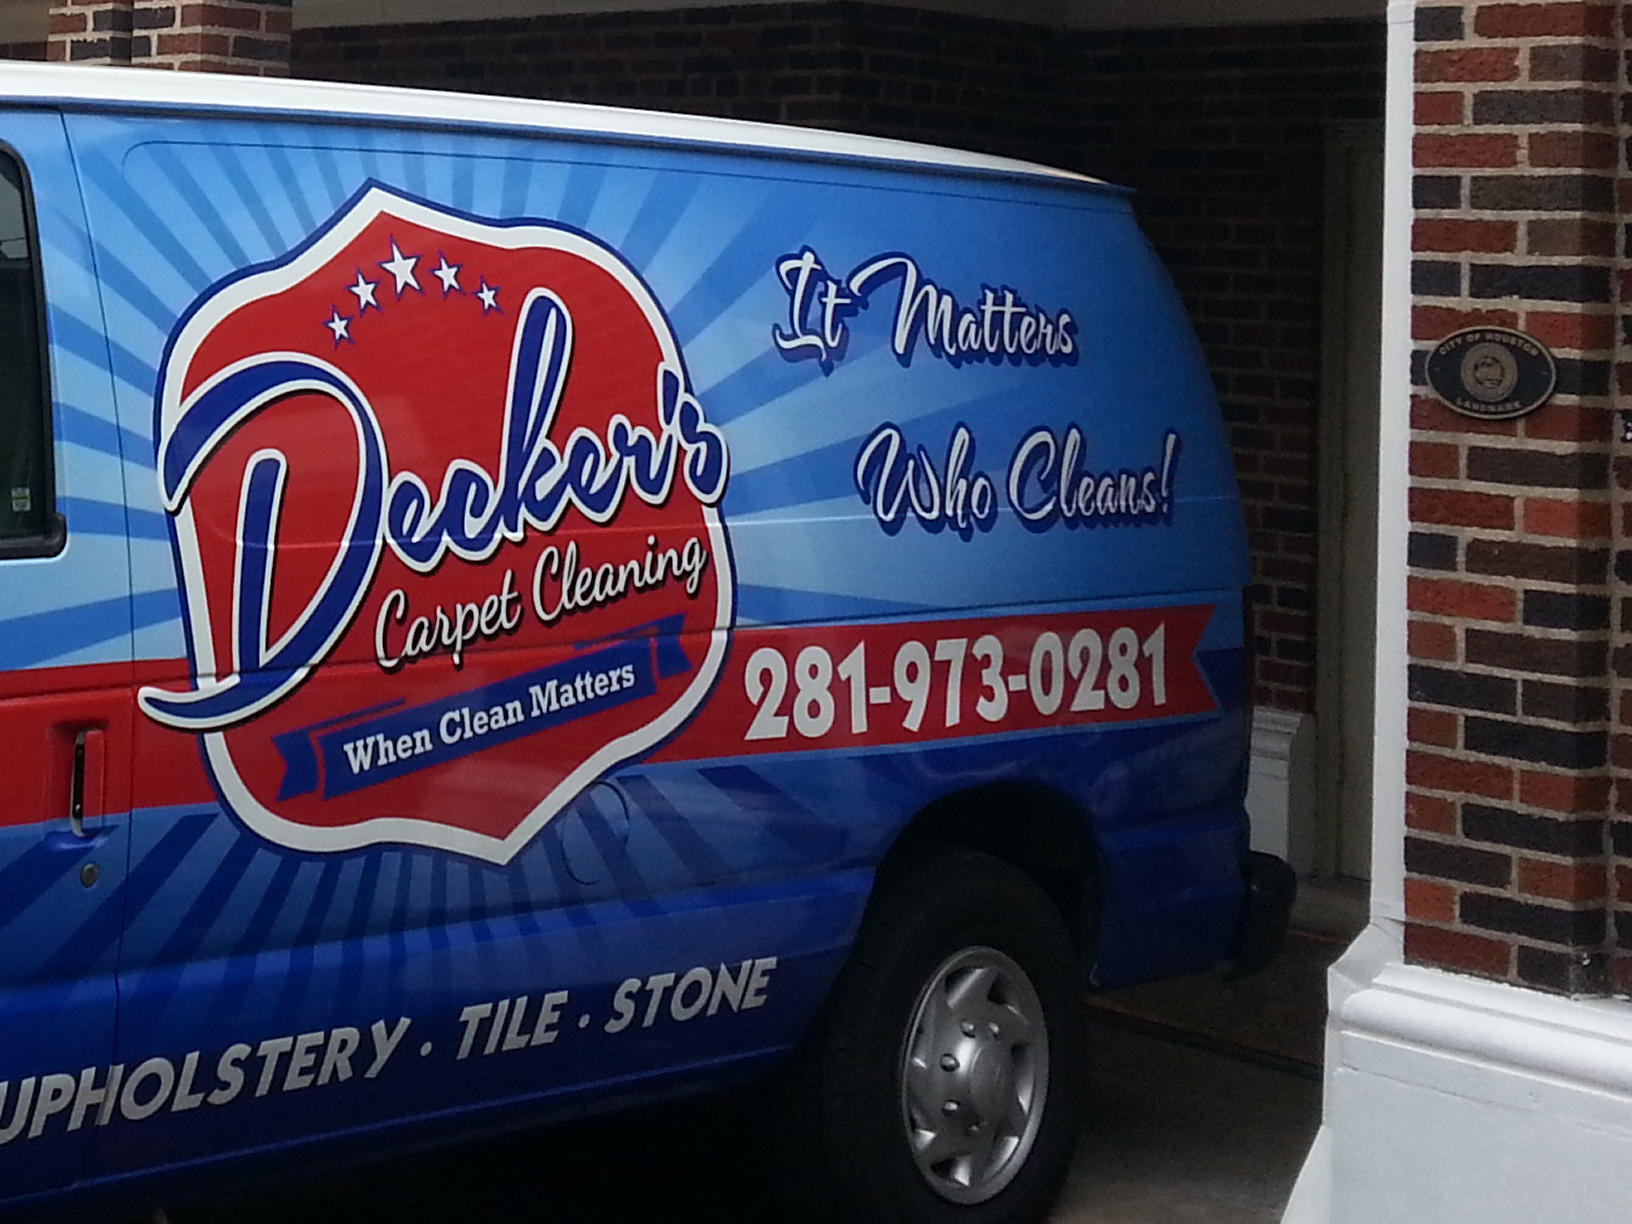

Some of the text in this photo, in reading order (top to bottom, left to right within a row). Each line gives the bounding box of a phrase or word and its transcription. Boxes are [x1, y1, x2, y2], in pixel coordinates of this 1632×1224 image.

[772, 247, 1076, 366] It Matters
[1439, 333, 1540, 356] CITY OF HOUSTON
[137, 285, 731, 731] Decker's
[856, 425, 1178, 530] Who Cleans!
[374, 533, 707, 671] Carpet Cleaning
[343, 661, 637, 776] When Clean Matters
[743, 620, 1168, 742] 281-973-0281
[453, 988, 571, 1063] TILE
[601, 954, 780, 1036] STONE
